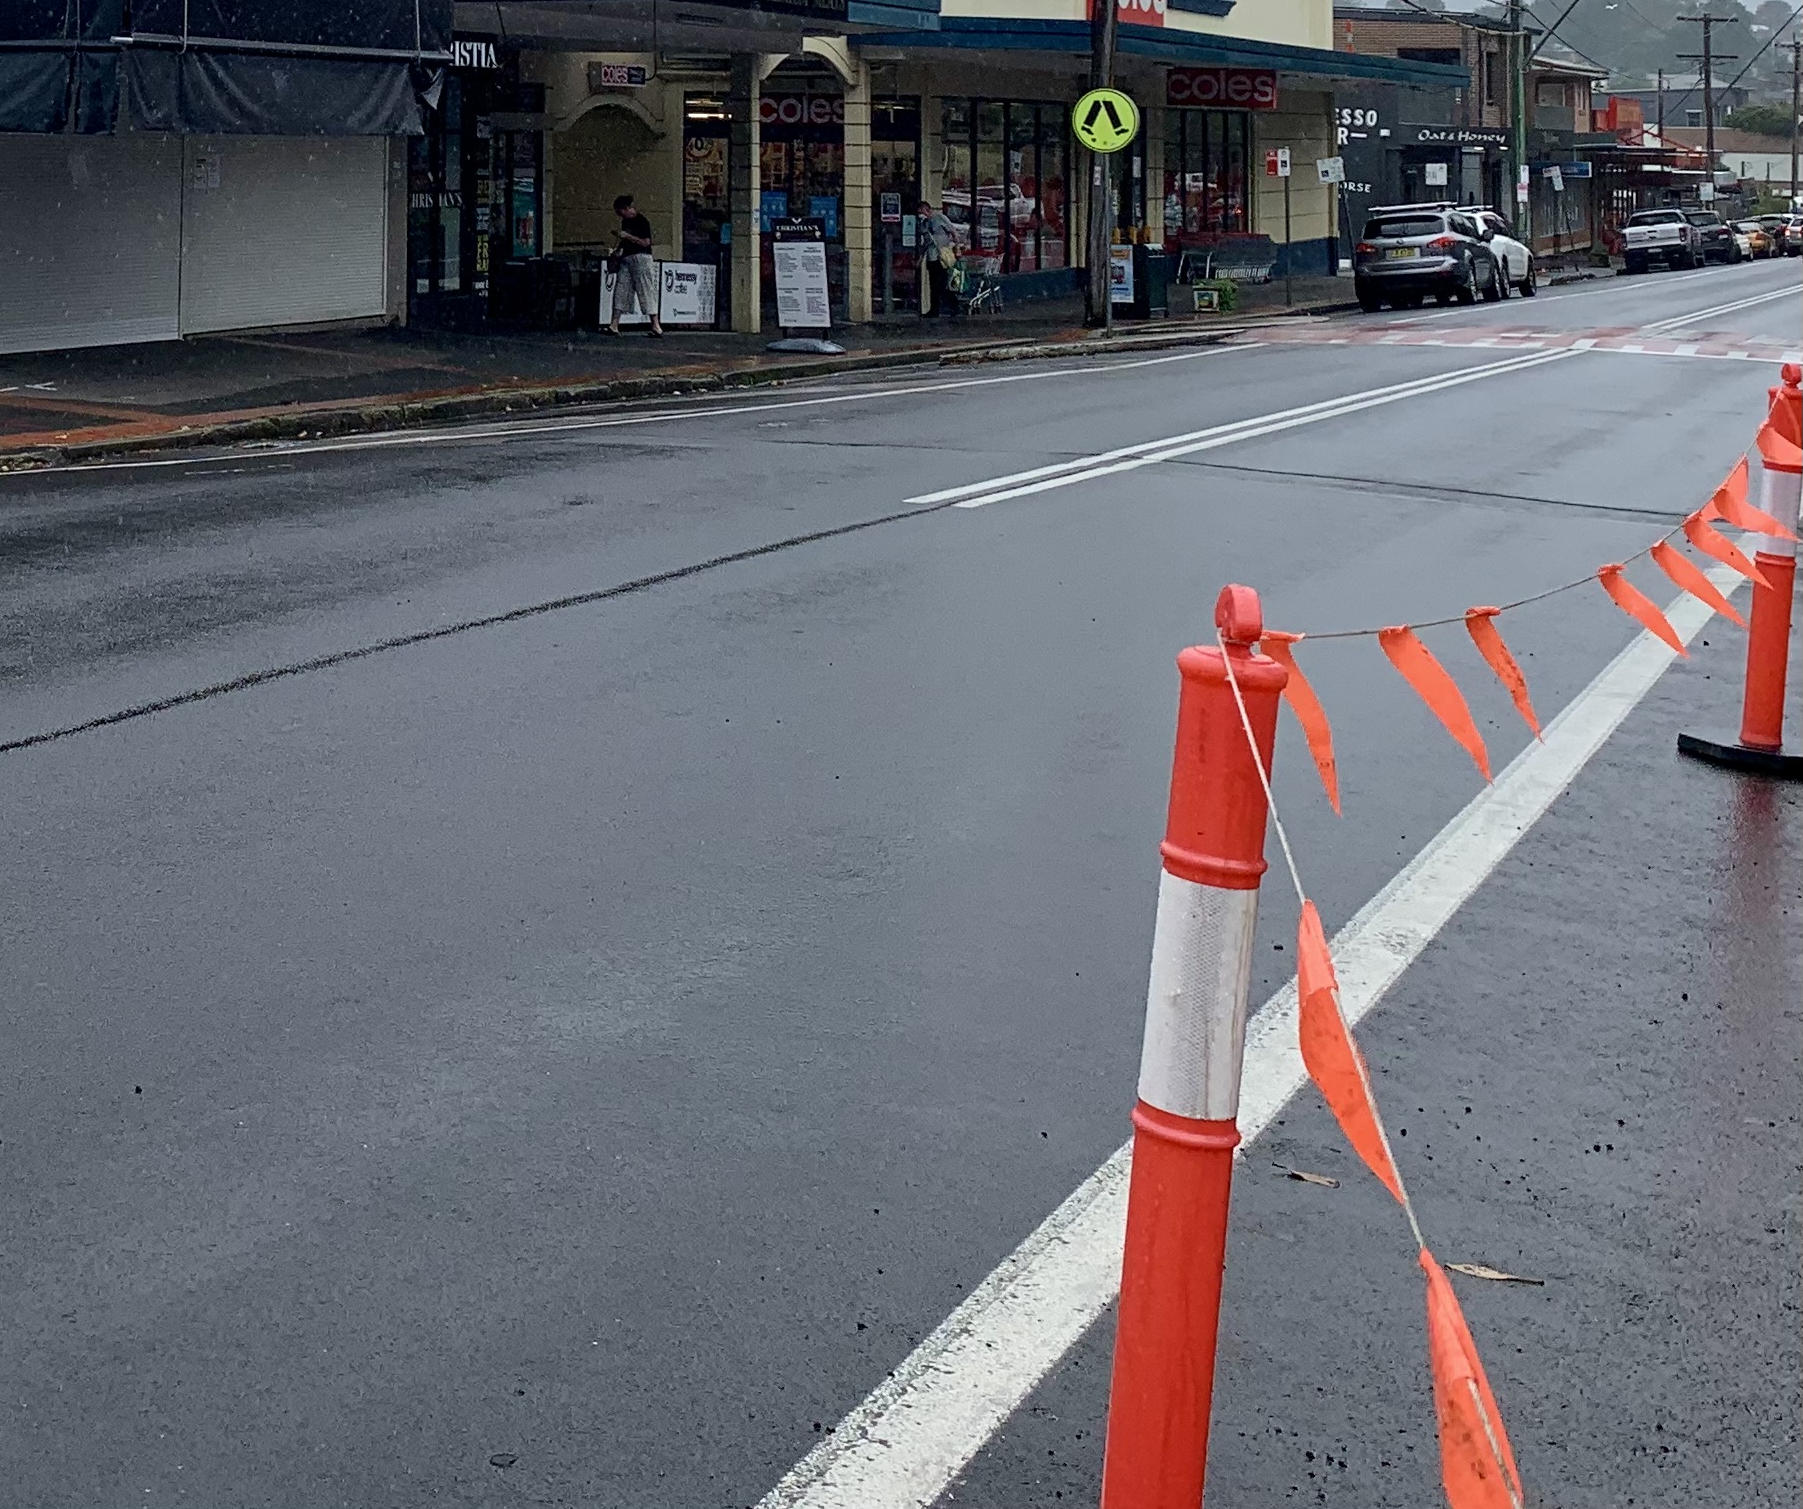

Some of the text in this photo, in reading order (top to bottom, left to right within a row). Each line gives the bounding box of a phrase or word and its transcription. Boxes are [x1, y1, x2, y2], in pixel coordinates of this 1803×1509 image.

[1168, 70, 1274, 102] coles
[1417, 129, 1445, 142] Oat
[1458, 130, 1507, 144] Honey
